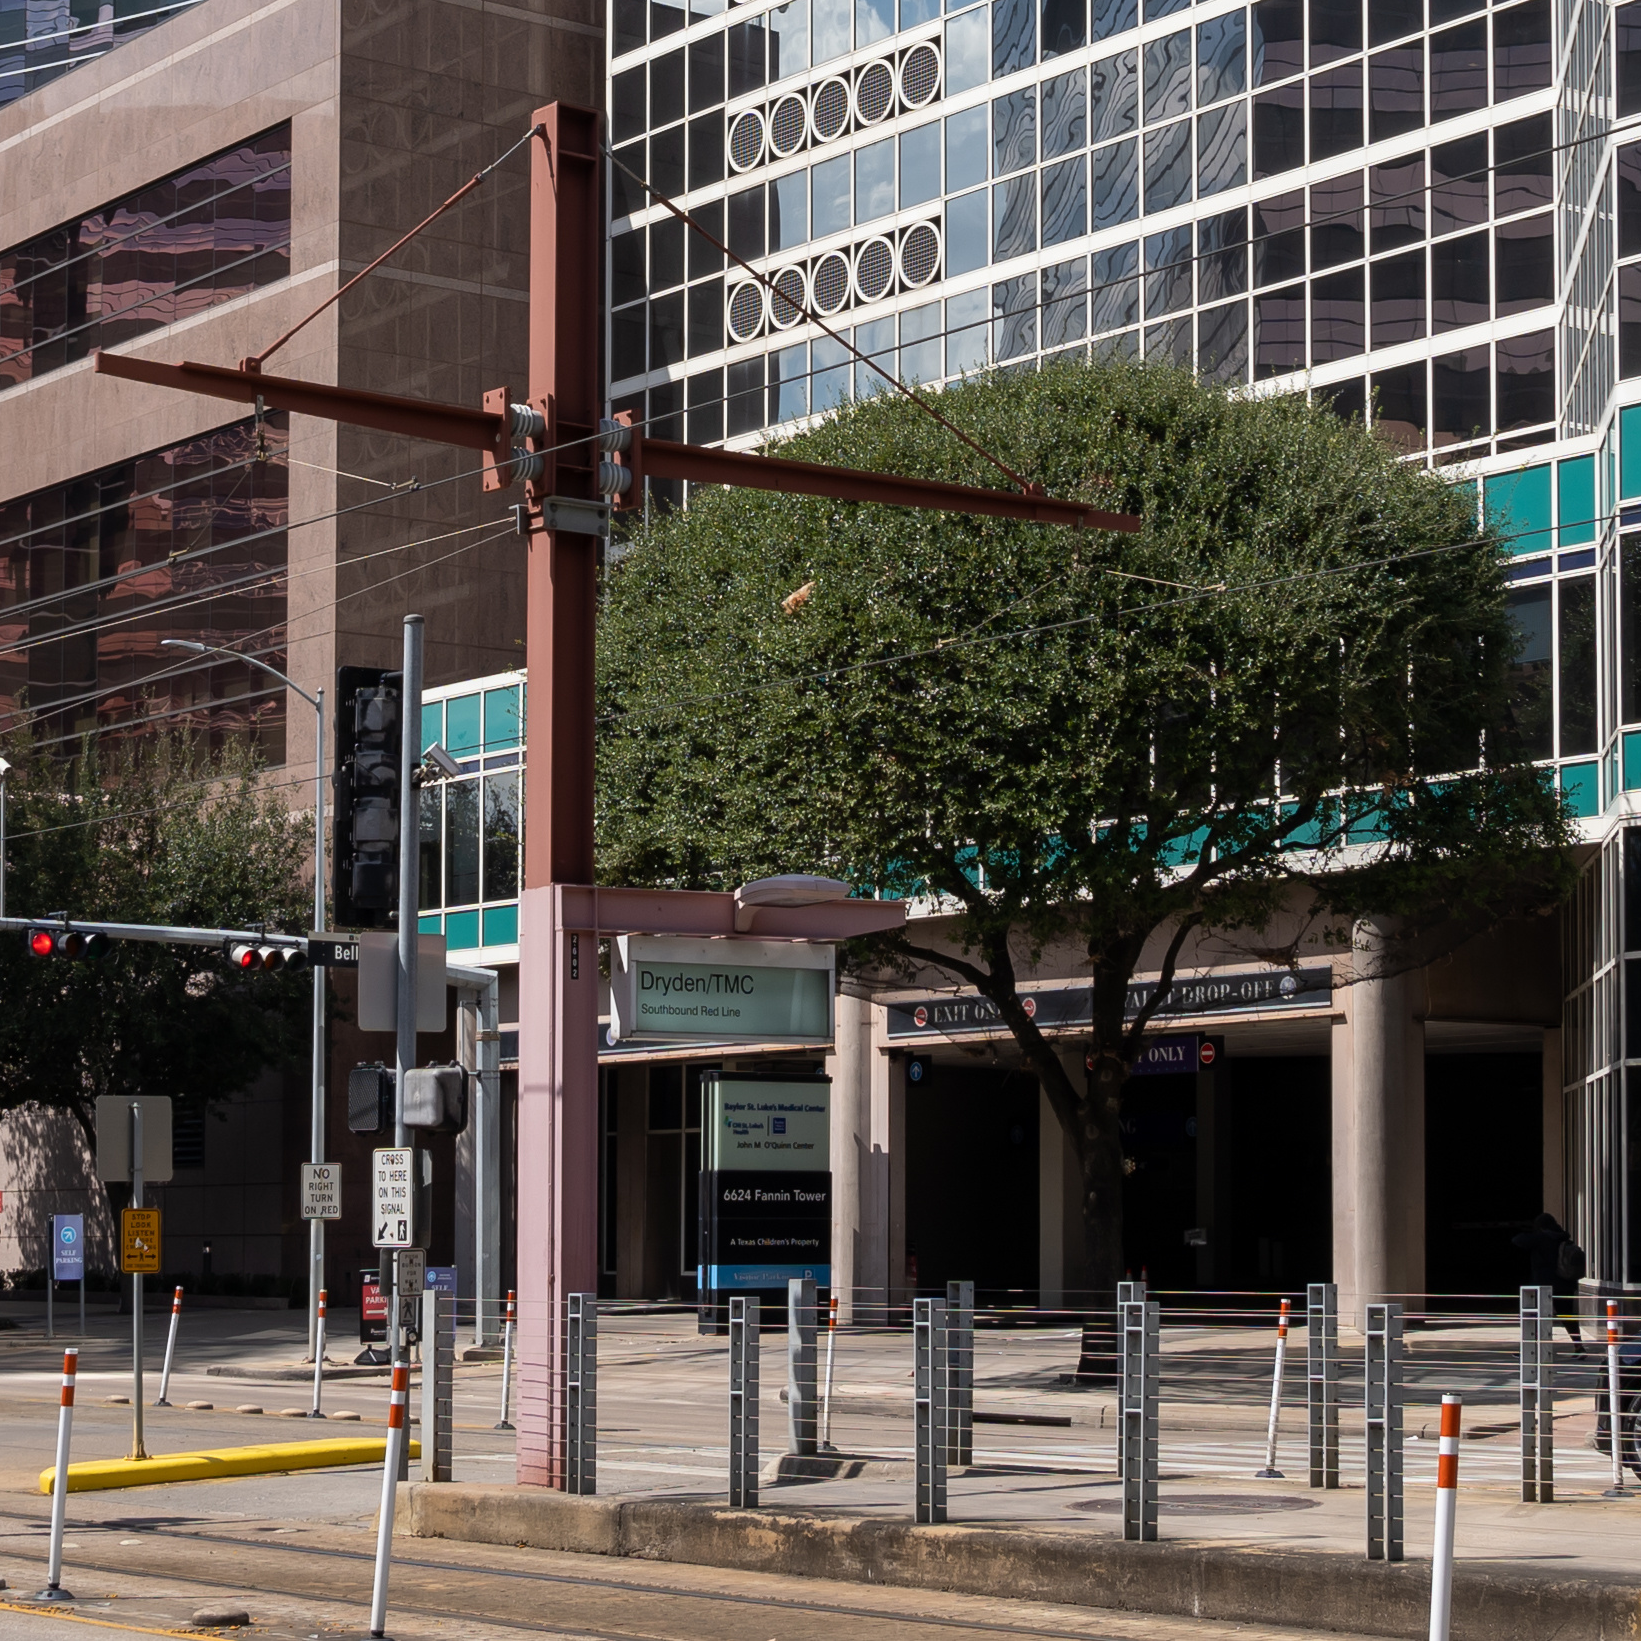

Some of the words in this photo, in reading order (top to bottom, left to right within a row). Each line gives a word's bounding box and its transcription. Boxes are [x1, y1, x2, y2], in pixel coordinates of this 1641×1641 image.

[641, 970, 754, 996] Dryden/TMC
[641, 1004, 698, 1017] Southbound
[701, 1005, 719, 1017] Red
[722, 1007, 741, 1018] Line
[934, 1004, 969, 1023] EXIT
[975, 1002, 1001, 1020] ON
[1149, 1046, 1185, 1063] ONLY
[724, 1102, 746, 1112] Baylor
[778, 1104, 803, 1112] Medical
[737, 1141, 752, 1149] John
[381, 1154, 404, 1166] CROSS
[313, 1168, 330, 1179] NO
[378, 1170, 386, 1182] TO
[389, 1170, 407, 1181] HERE
[308, 1182, 334, 1191] RIGHT
[378, 1187, 388, 1198] ON
[391, 1186, 406, 1198] THIS
[310, 1194, 333, 1203] TURN
[723, 1189, 751, 1201] 6624
[754, 1189, 790, 1201] Fannin
[793, 1189, 826, 1201] Tower
[304, 1206, 316, 1215] ON
[321, 1206, 338, 1215] RED
[380, 1203, 405, 1215] SIGNAL
[738, 1238, 756, 1246] Texas
[791, 1239, 820, 1247] Property
[804, 1270, 812, 1280] P
[365, 1296, 387, 1304] PARKI
